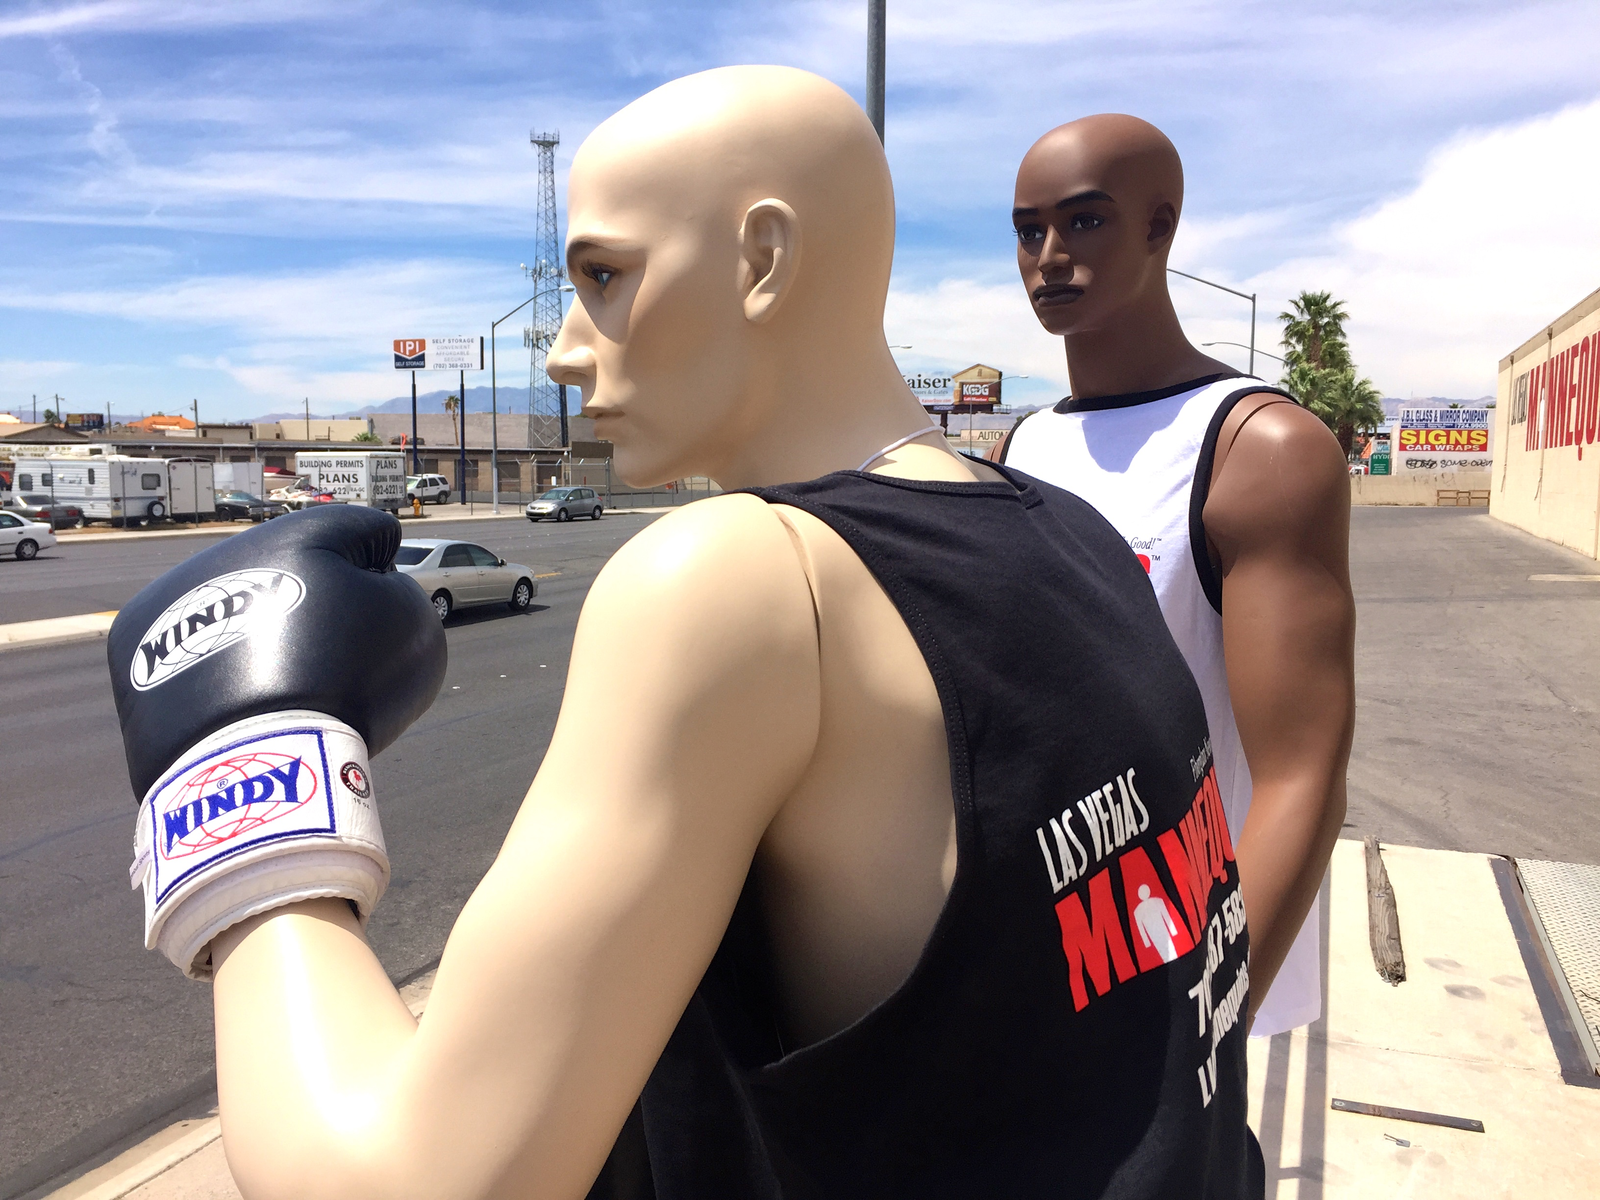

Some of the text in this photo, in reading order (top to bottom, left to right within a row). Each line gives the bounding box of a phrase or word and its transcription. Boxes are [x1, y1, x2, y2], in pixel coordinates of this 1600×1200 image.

[400, 340, 419, 355] IPI
[903, 373, 951, 389] aiser
[1415, 410, 1433, 422] GLASS
[1439, 410, 1461, 422] MIRROR
[1461, 410, 1489, 423] COMPANY
[1400, 429, 1487, 445] SIGNS
[299, 460, 364, 468] BUILDING PERMITS
[376, 460, 398, 469] PLANS
[319, 473, 359, 484] PLANS
[163, 755, 302, 857] WINDY
[1036, 766, 1150, 895] LAS VEGAS
